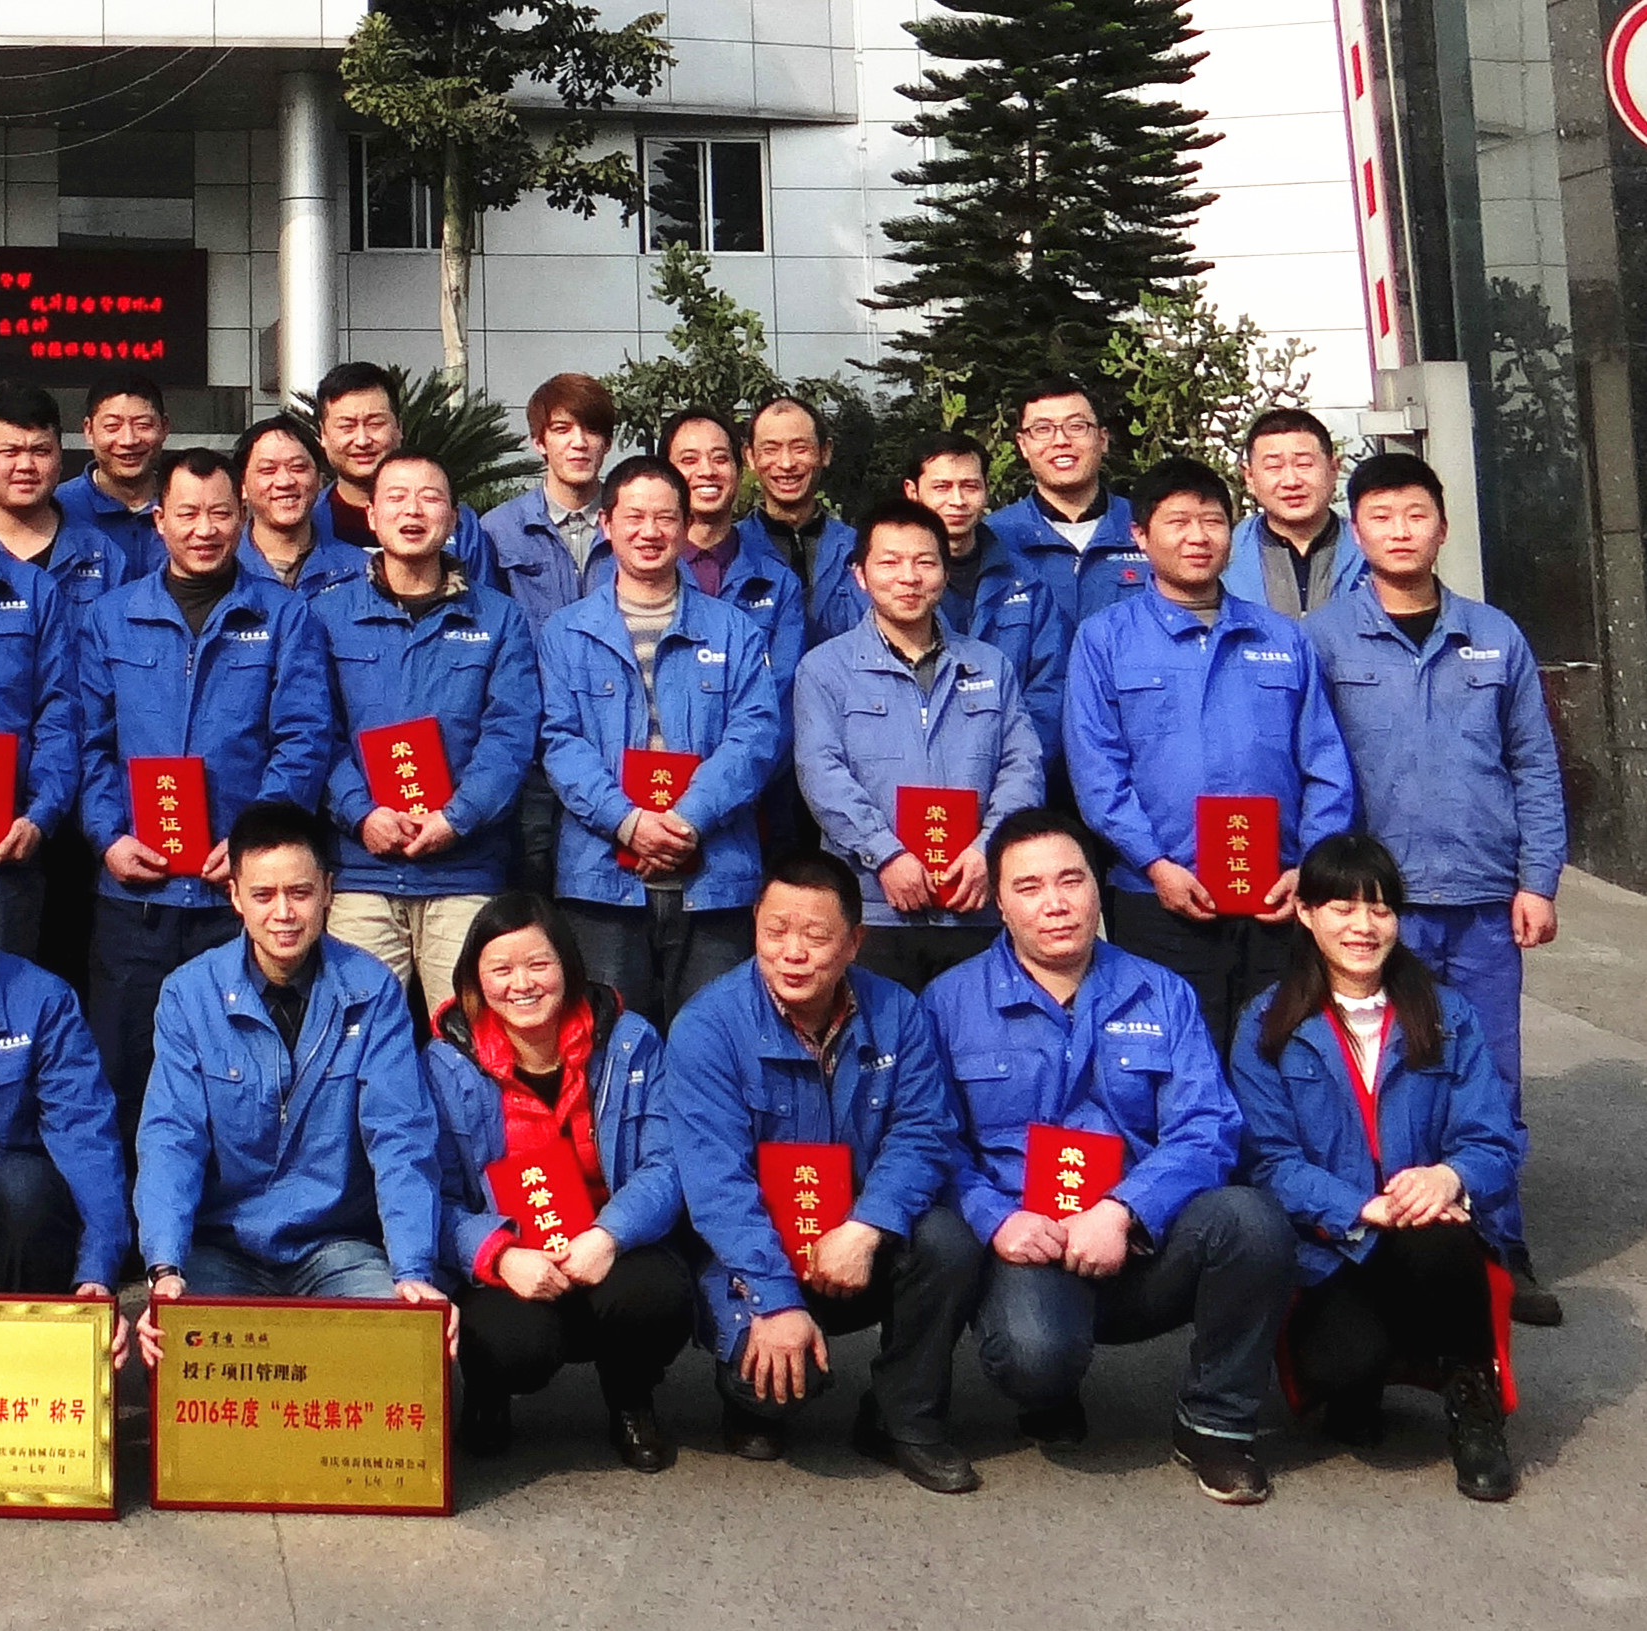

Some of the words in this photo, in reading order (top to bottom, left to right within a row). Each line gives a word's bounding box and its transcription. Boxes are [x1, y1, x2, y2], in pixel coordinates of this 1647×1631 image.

[156, 775, 185, 854] 荣誉证书
[1226, 814, 1252, 895] 荣誉证书
[520, 1166, 569, 1253] 荣誉证书
[183, 1361, 216, 1380] 授予
[221, 1362, 308, 1383] 项目管理部
